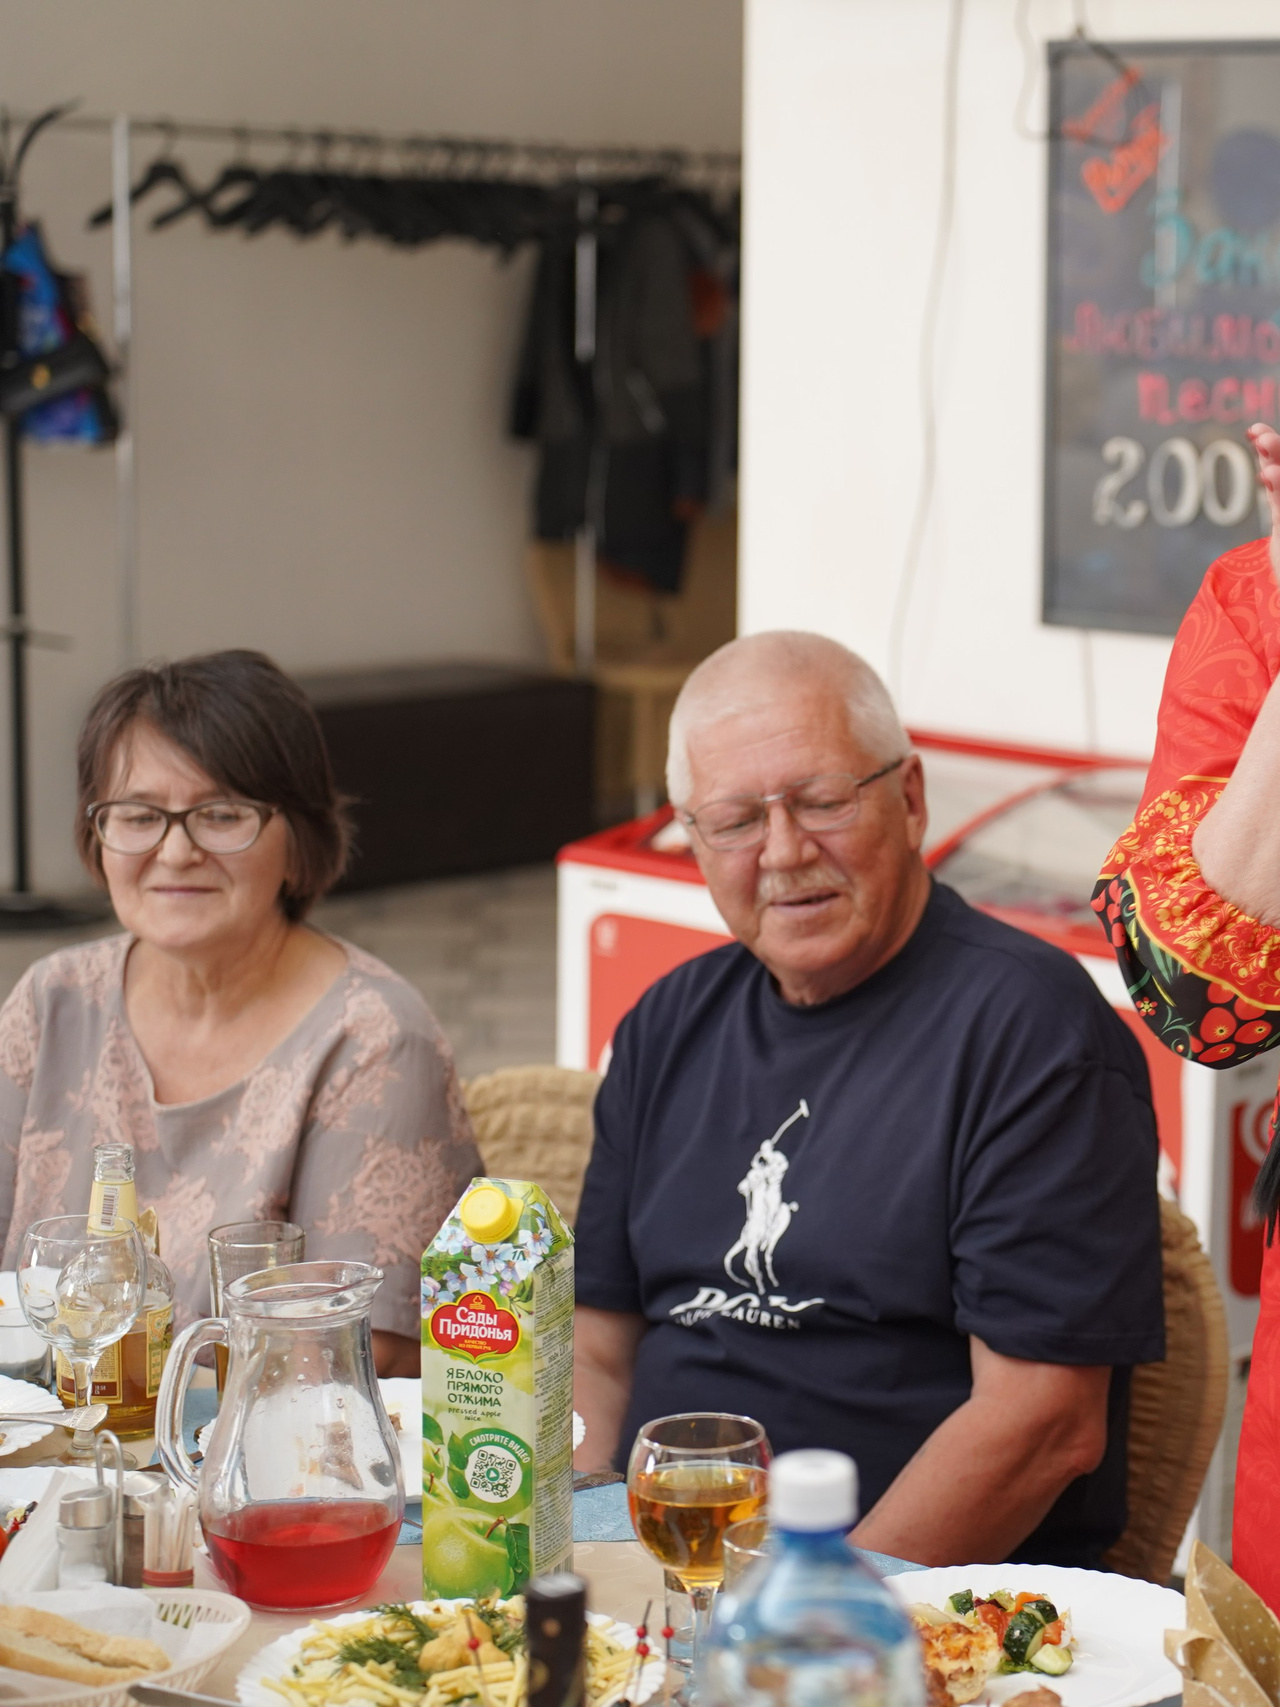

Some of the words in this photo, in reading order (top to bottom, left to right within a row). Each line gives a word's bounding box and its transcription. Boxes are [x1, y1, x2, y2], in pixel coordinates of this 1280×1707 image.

[455, 1306, 498, 1326] Сады
[438, 1318, 512, 1341] Придонья
[446, 1367, 504, 1383] ЯБЛОКО
[447, 1380, 503, 1395] ПРЯМОГО
[447, 1393, 502, 1407] ОТЖИМА
[448, 1407, 477, 1415] pressed
[469, 1433, 510, 1447] СМОТРИТЕ
[508, 1440, 531, 1464] ВИДЕО
